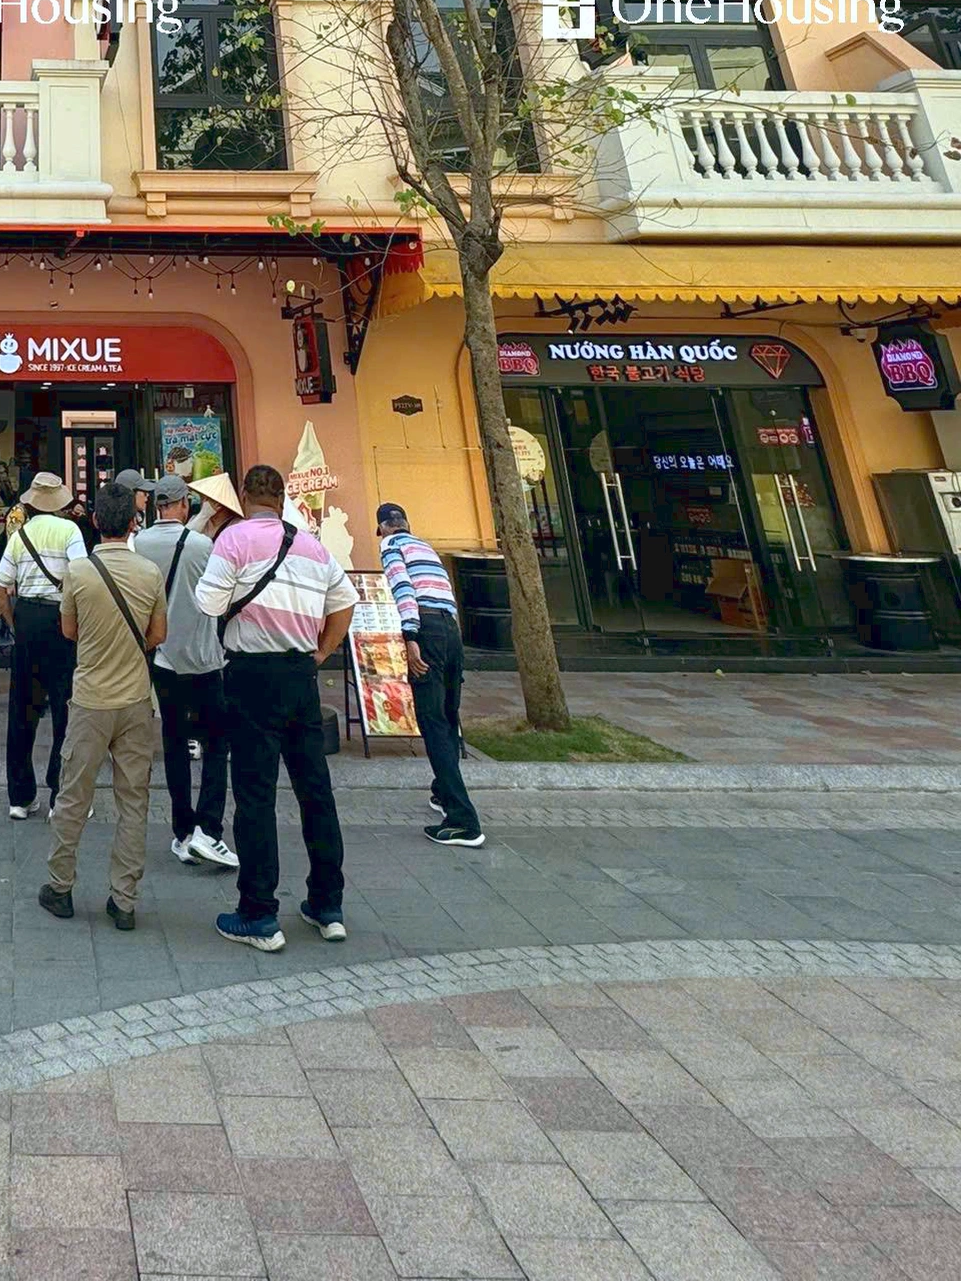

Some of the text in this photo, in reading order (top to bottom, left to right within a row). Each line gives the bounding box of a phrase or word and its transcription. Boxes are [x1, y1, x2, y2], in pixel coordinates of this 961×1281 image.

[28, 337, 122, 362] MIXUE
[548, 339, 738, 363] NƯỚNG HÀN QUỐC
[886, 350, 924, 362] DIAMOND
[28, 364, 48, 372] SINCE
[77, 364, 102, 372] CREAM
[499, 358, 538, 375] BBQ
[589, 365, 706, 382] 한국 불고기 식당
[887, 362, 935, 387] BBQ
[653, 454, 678, 469] 당신의
[679, 455, 706, 470] 오늘은
[309, 466, 329, 477] NO.1
[285, 476, 339, 495] CE CREAM
